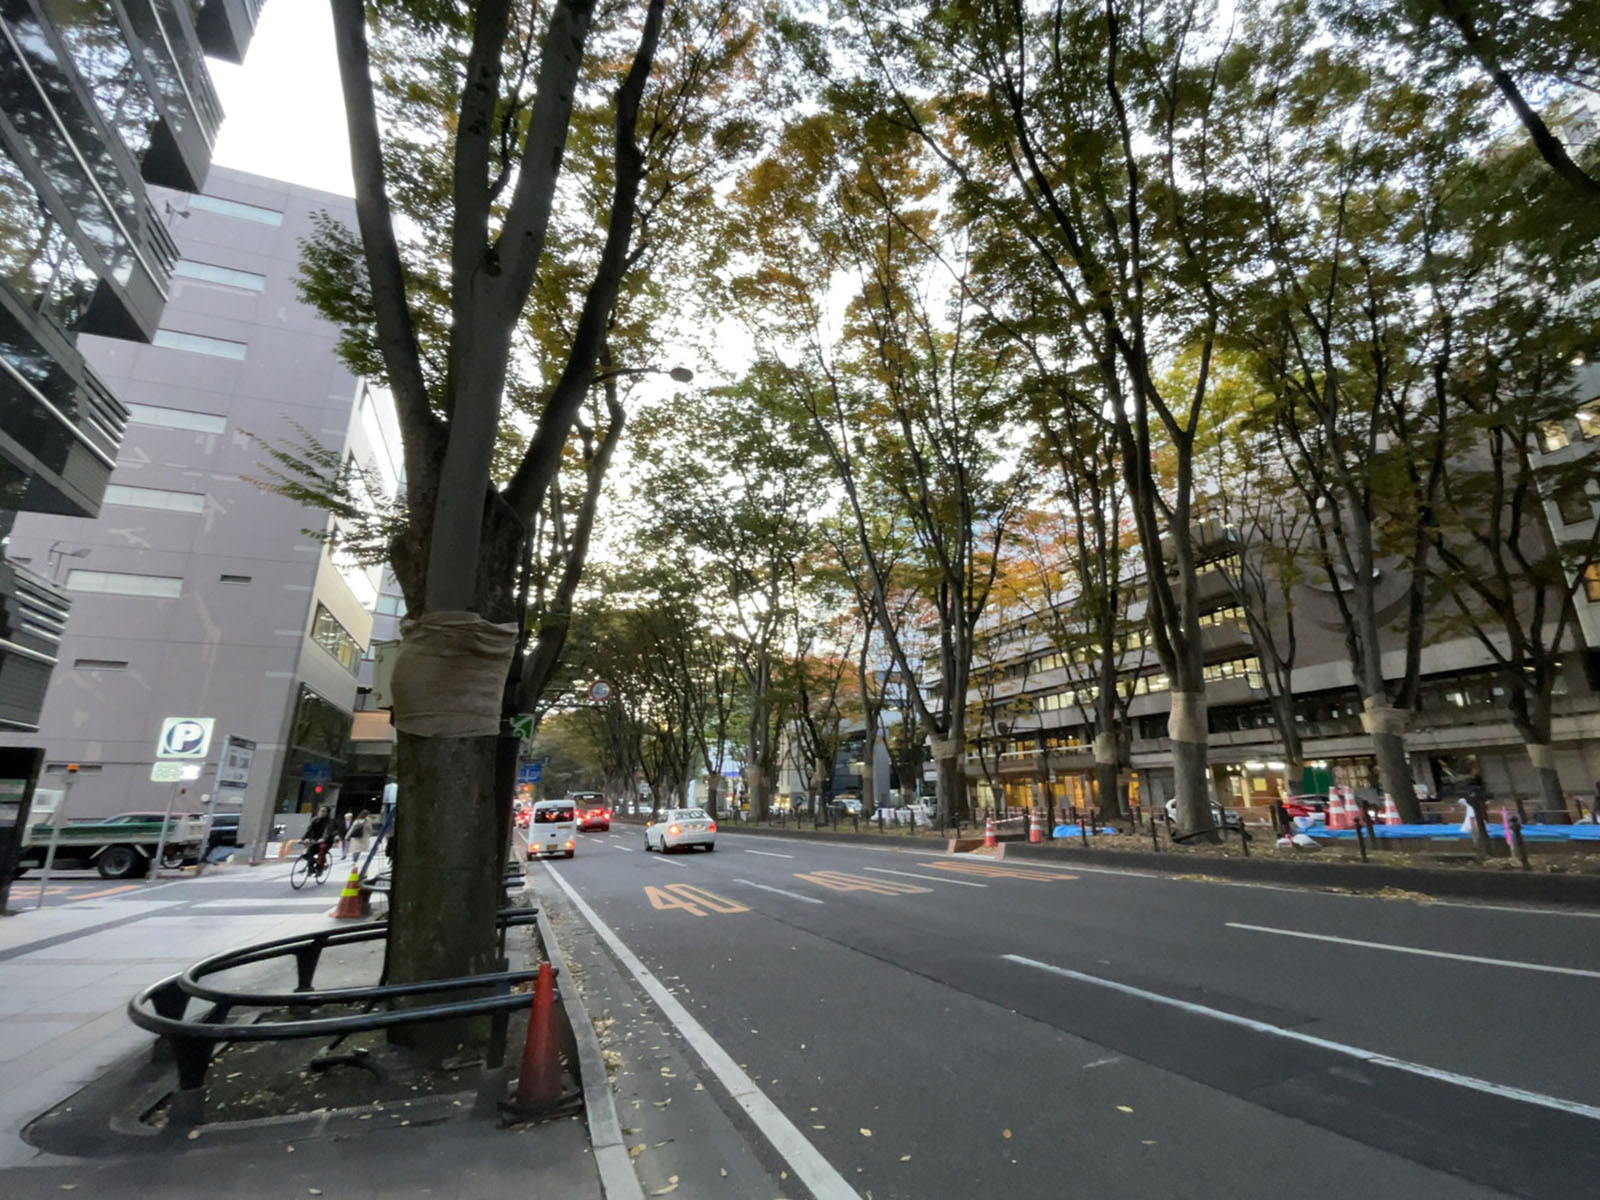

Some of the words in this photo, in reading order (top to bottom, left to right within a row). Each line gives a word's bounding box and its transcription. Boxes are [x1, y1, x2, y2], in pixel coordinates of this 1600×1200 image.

[169, 723, 204, 751] P
[793, 871, 935, 896] 40
[644, 883, 751, 917] 40
